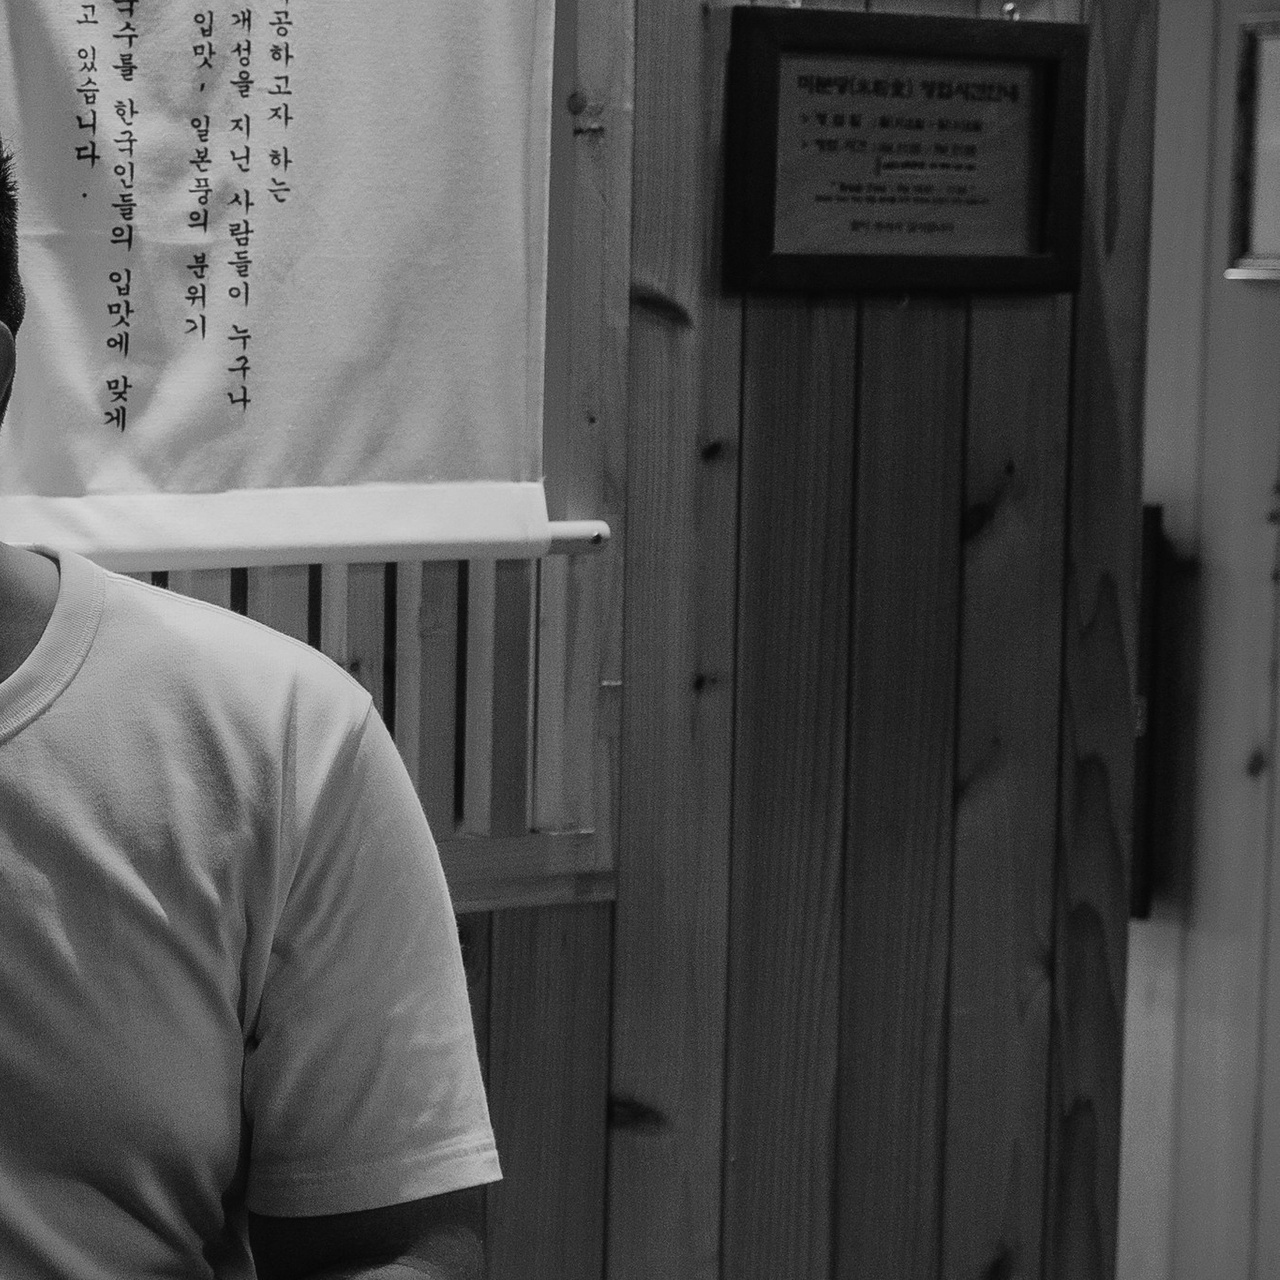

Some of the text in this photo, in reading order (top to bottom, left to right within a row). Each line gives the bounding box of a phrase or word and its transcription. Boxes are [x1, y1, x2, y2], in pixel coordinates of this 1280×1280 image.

[230, 8, 254, 98] 개성을
[110, 98, 139, 252] 한국인들의
[188, 115, 213, 233] 일본풍의
[230, 114, 250, 173] 지닌
[268, 146, 292, 203] 하는
[227, 189, 254, 307] 사람들이
[107, 268, 134, 358] 입맛에
[185, 252, 209, 339] 분위기
[104, 375, 133, 433] 맞게
[227, 324, 251, 412] 누구나
